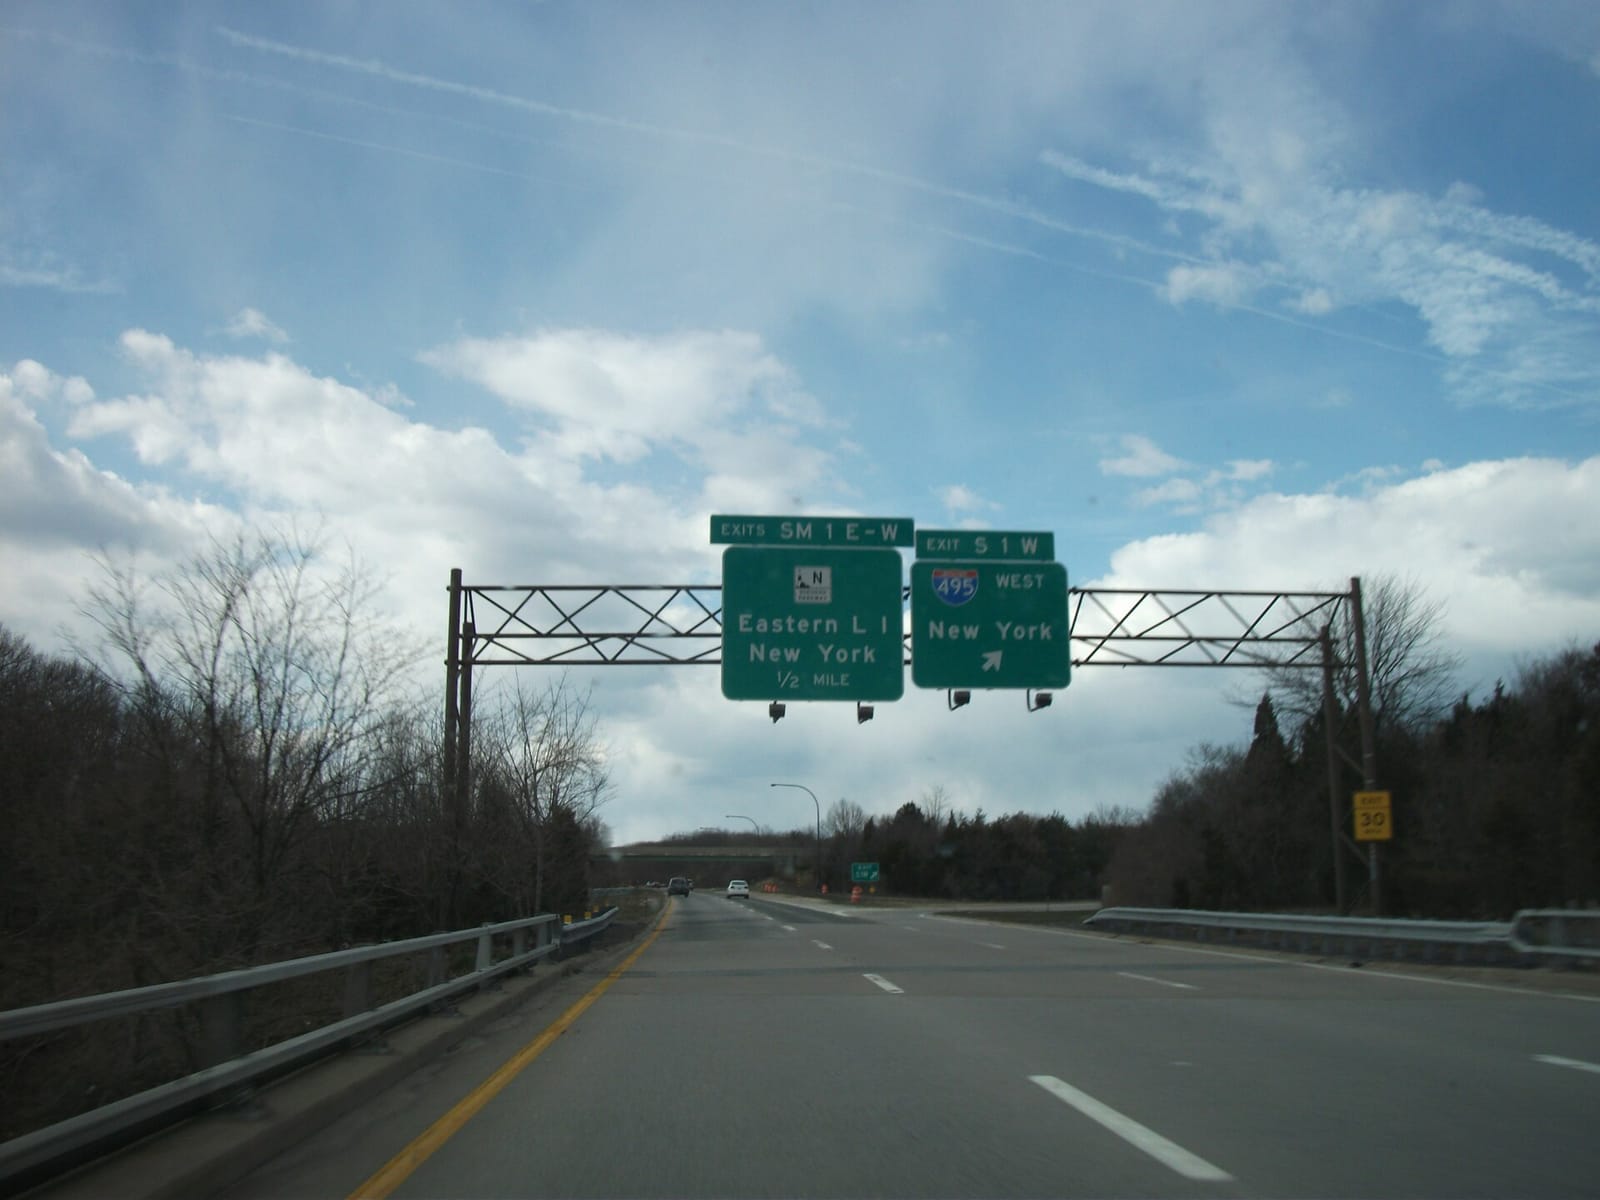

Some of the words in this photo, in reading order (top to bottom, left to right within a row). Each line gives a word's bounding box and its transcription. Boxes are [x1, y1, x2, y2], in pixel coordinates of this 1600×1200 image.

[721, 524, 765, 536] EXITS
[780, 522, 812, 540] SM
[826, 523, 833, 539] 1
[927, 538, 960, 551] EXIT
[975, 536, 988, 553] S
[1002, 537, 1008, 554] 1
[1021, 536, 1038, 555] W
[813, 571, 822, 584] N
[937, 577, 974, 596] 495
[996, 573, 1044, 589] WEST
[739, 614, 837, 633] Eastern
[853, 616, 866, 634] L
[929, 621, 979, 639] New
[996, 621, 1052, 640] York
[750, 643, 800, 662] New
[818, 644, 876, 663] York
[777, 671, 800, 688] 1/2
[813, 673, 850, 686] MILE
[1360, 811, 1385, 826] 30
